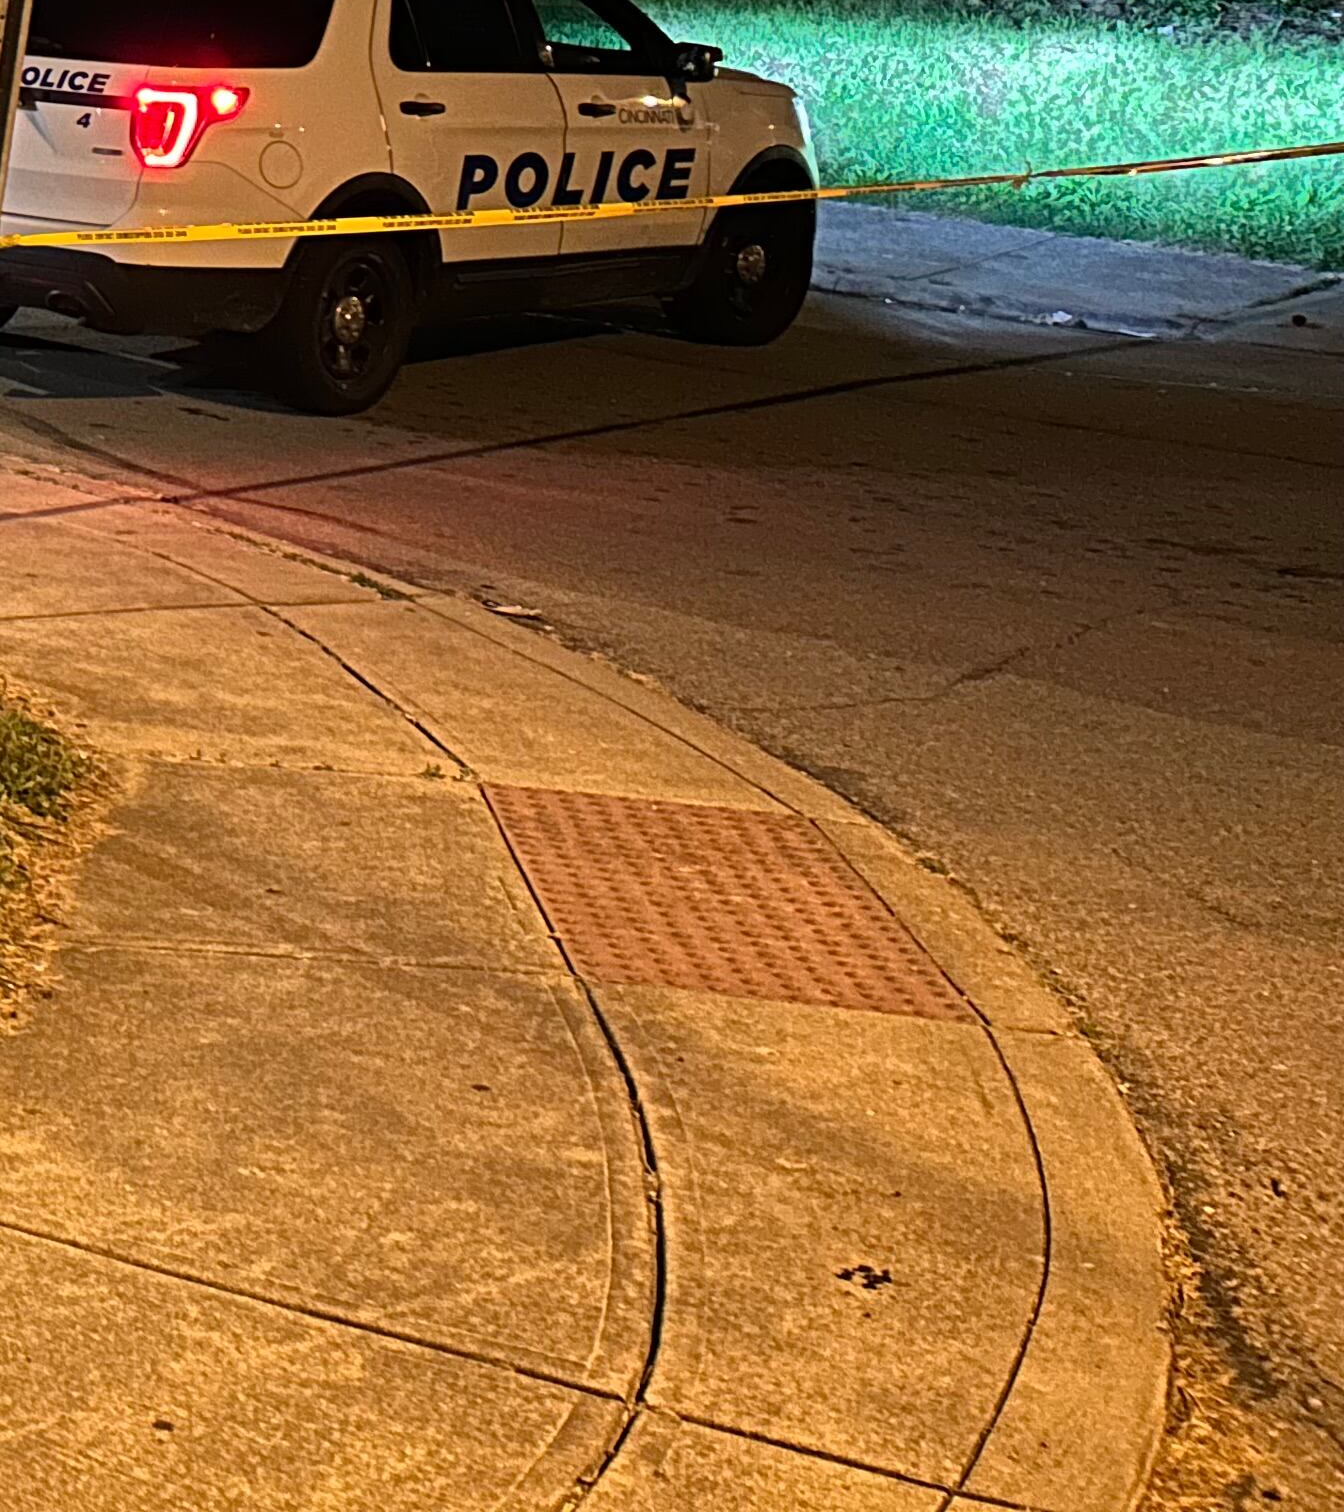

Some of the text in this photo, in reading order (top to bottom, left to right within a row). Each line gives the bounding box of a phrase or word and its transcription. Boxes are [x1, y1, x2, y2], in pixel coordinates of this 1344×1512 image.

[21, 66, 112, 93] OLICE
[76, 112, 93, 129] 4
[456, 148, 697, 210] POLICE
